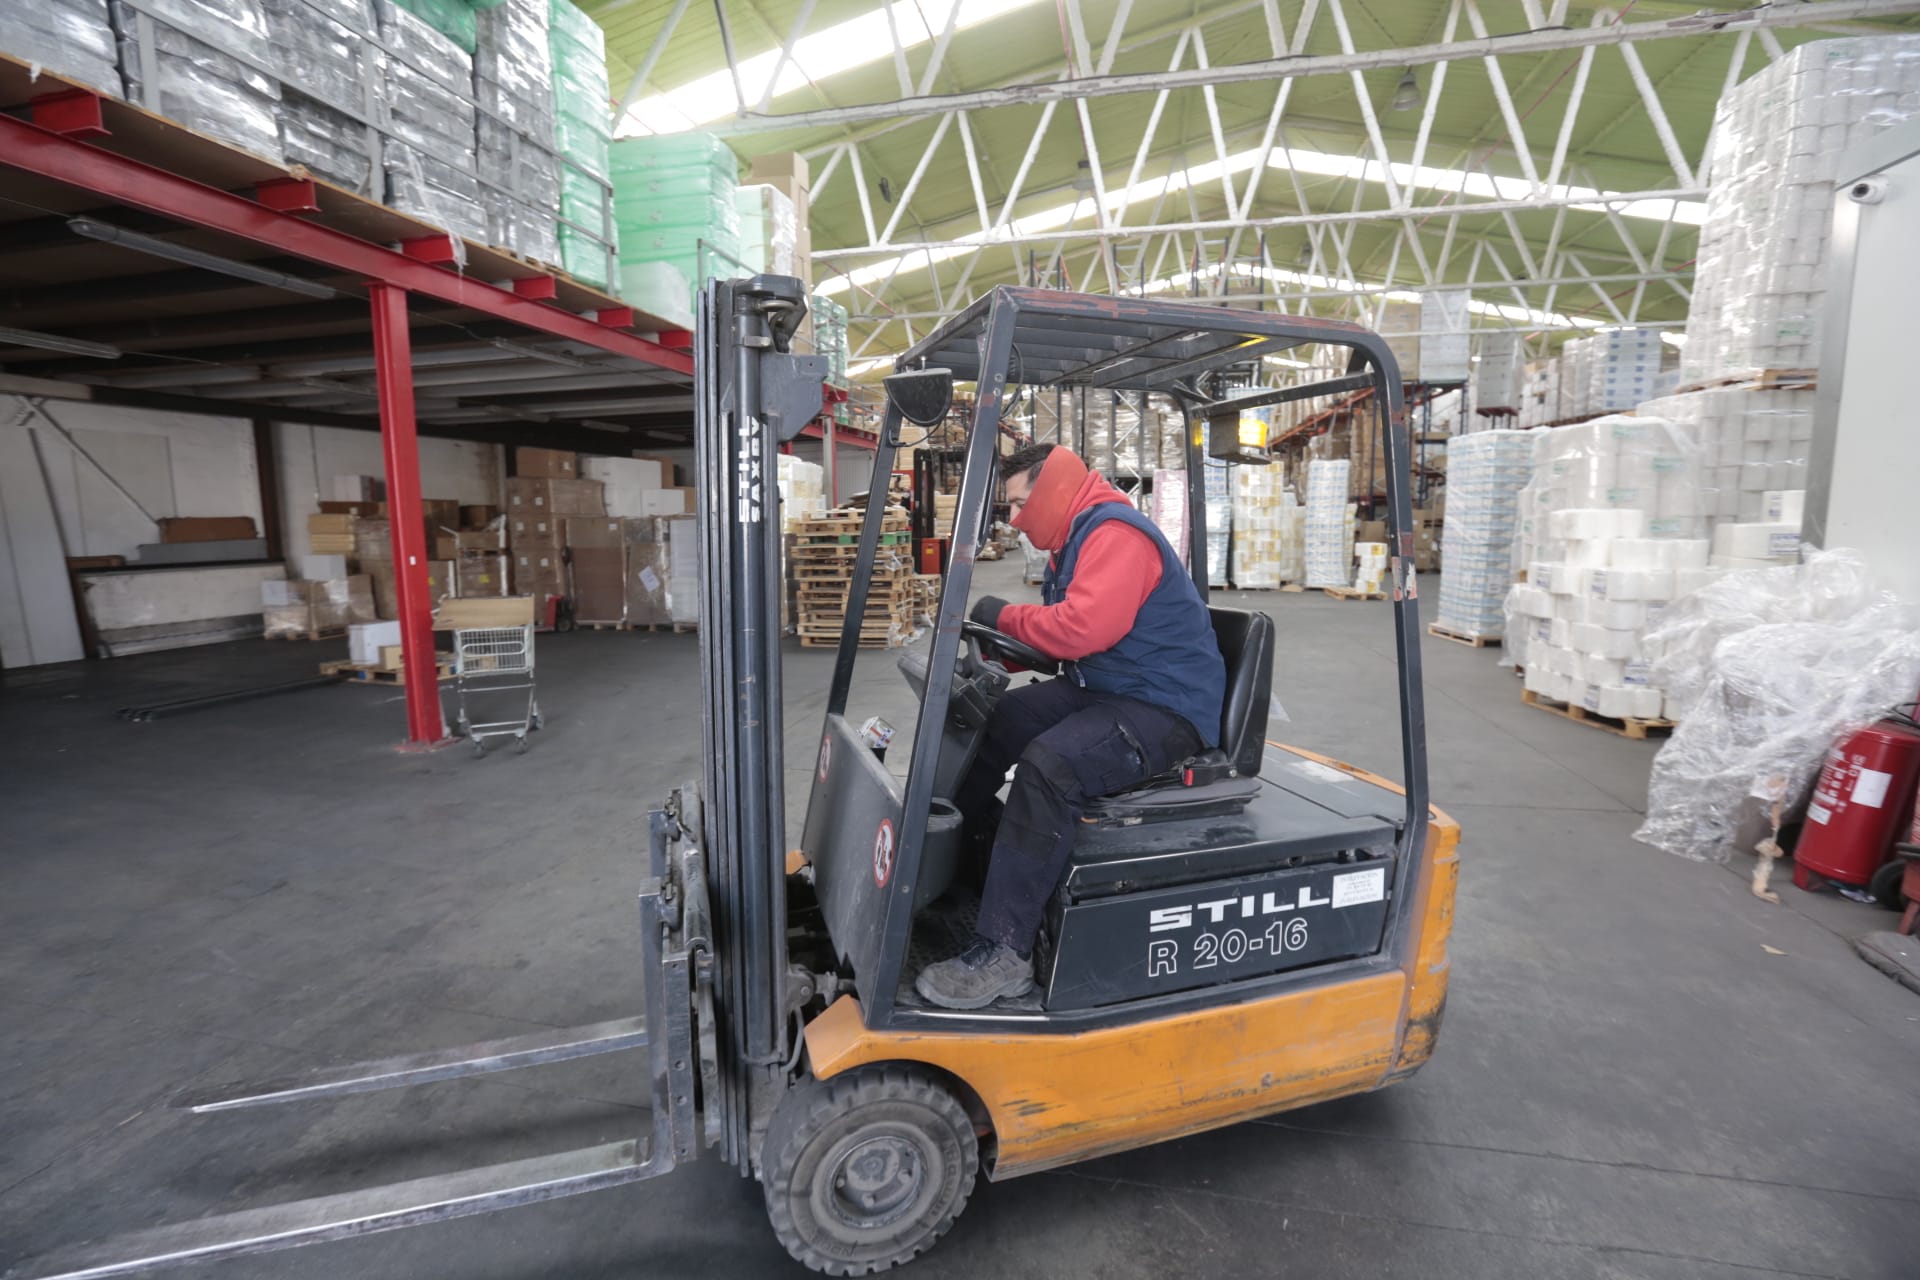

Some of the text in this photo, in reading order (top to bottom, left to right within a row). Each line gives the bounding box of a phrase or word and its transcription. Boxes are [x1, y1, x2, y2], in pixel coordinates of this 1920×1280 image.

[738, 415, 750, 523] STILL
[751, 416, 760, 522] SAXBY
[1148, 917, 1308, 978] R 20-16
[1150, 886, 1330, 932] STILL
